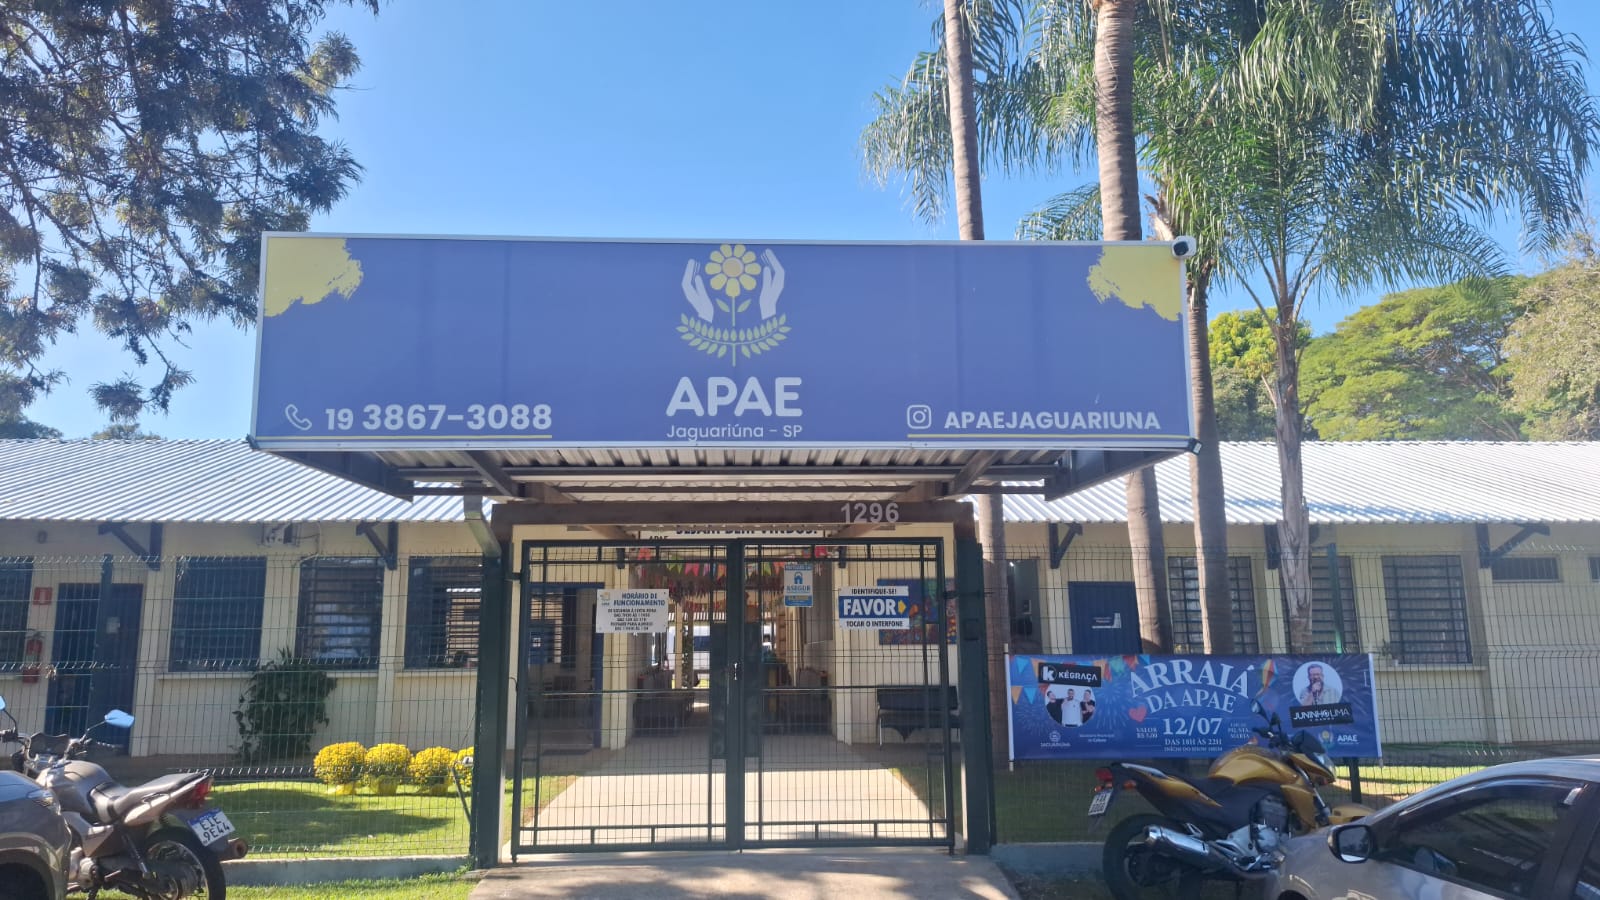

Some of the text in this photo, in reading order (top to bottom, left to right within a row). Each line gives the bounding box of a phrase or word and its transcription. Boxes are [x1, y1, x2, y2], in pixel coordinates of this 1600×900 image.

[666, 376, 803, 416] APAE
[326, 404, 552, 430] 19 3867-3088
[944, 412, 1160, 429] APAEJAGUARIUNA
[666, 424, 764, 441] Jaguariúna
[783, 425, 803, 438] SP
[840, 502, 900, 524] 1296
[844, 599, 896, 616] FAVOR
[1130, 659, 1254, 699] ARRAIÁ
[1145, 689, 1236, 714] DA APAE
[1162, 716, 1223, 736] 12/07
[204, 823, 230, 841] 9E44
